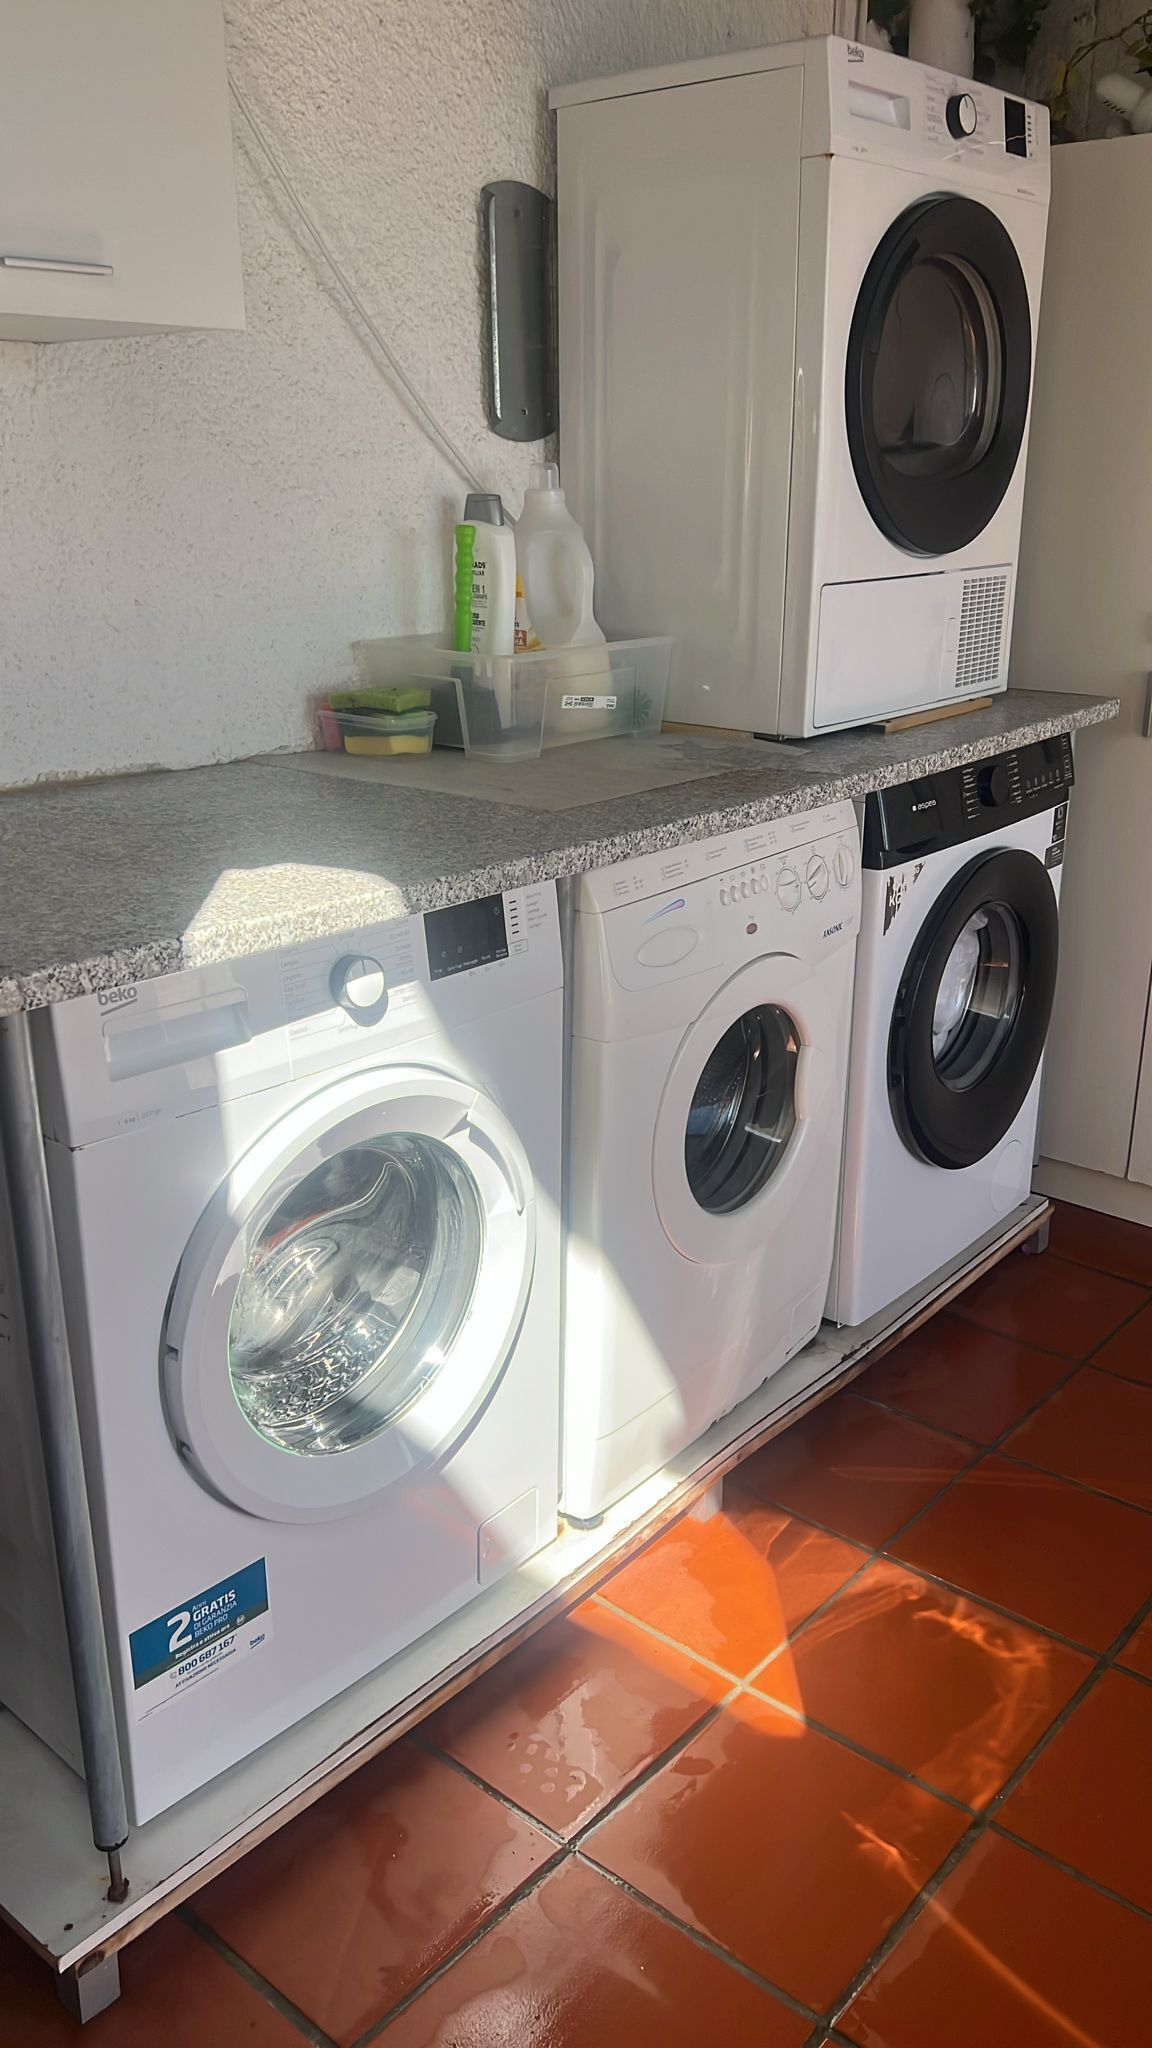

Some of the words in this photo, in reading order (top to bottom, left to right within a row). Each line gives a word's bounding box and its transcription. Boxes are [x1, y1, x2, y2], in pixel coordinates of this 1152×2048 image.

[847, 43, 864, 59] beko
[97, 986, 138, 1006] beko
[192, 1600, 207, 1612] Anni
[193, 1589, 236, 1622] GRATIS
[202, 1600, 238, 1626] GARANZIA
[167, 1611, 193, 1653] 2
[194, 1623, 213, 1638] BEKO
[213, 1613, 228, 1626] PRO
[249, 1633, 265, 1646] beko
[175, 1642, 199, 1660] Registra
[177, 1658, 198, 1676] 800
[198, 1646, 218, 1663] 687
